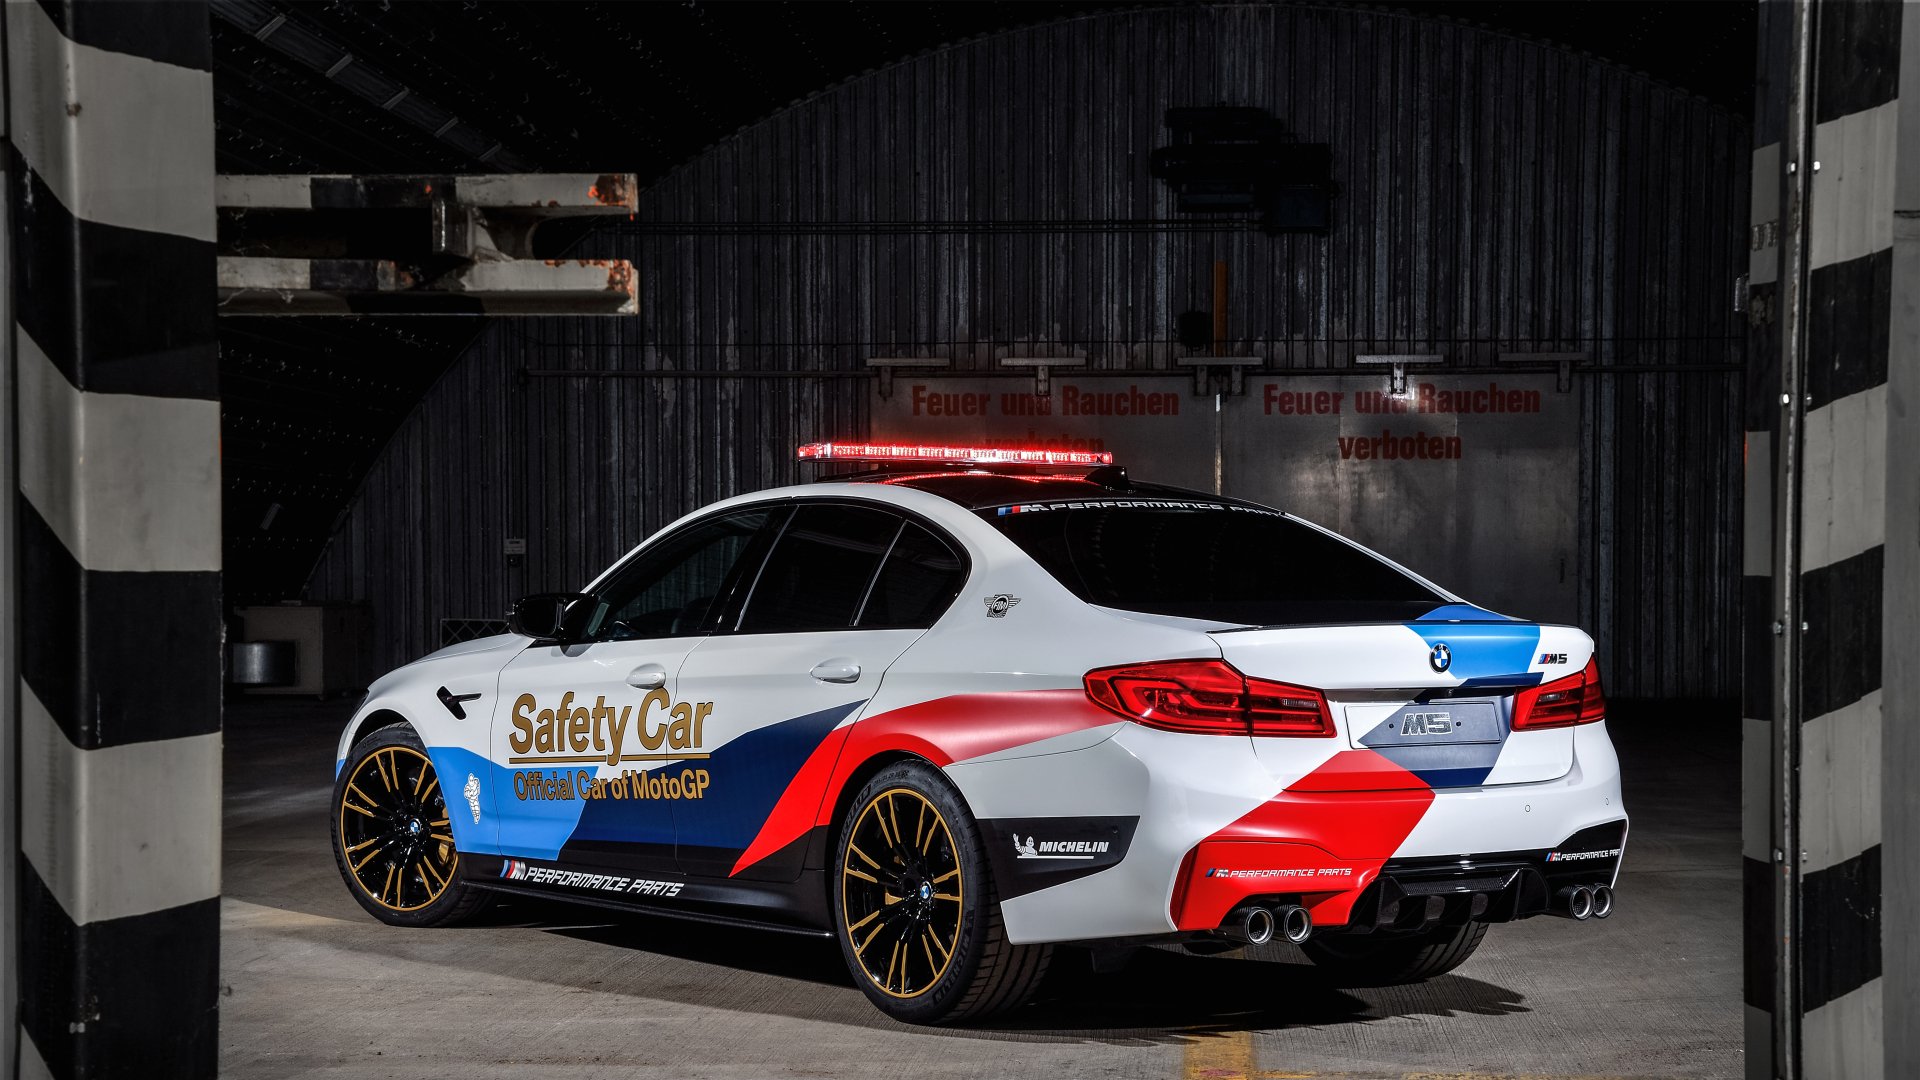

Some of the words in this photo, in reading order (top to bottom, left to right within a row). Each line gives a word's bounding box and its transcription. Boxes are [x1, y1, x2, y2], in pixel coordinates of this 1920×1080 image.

[912, 385, 991, 416] Feuer
[1062, 385, 1179, 416] Rauchen
[1263, 384, 1344, 415] Feuer
[1418, 383, 1541, 414] Rauchen
[1338, 430, 1462, 460] verboten
[1050, 501, 1224, 510] PERFORMANCE
[1546, 653, 1568, 664] M5
[508, 691, 633, 766] Safety
[637, 687, 714, 751] Car
[1401, 712, 1452, 735] M5
[513, 769, 576, 800] Official
[576, 770, 609, 800] Car
[610, 769, 630, 799] of
[631, 769, 711, 800] MotoGP
[1039, 841, 1109, 853] MICHELIN
[1561, 849, 1609, 861] PERFORMANCE
[524, 866, 631, 892] PERFORMANCE
[626, 879, 685, 897] PARTS
[1230, 868, 1315, 878] PERFORMANCE
[1317, 868, 1352, 876] PARTS
